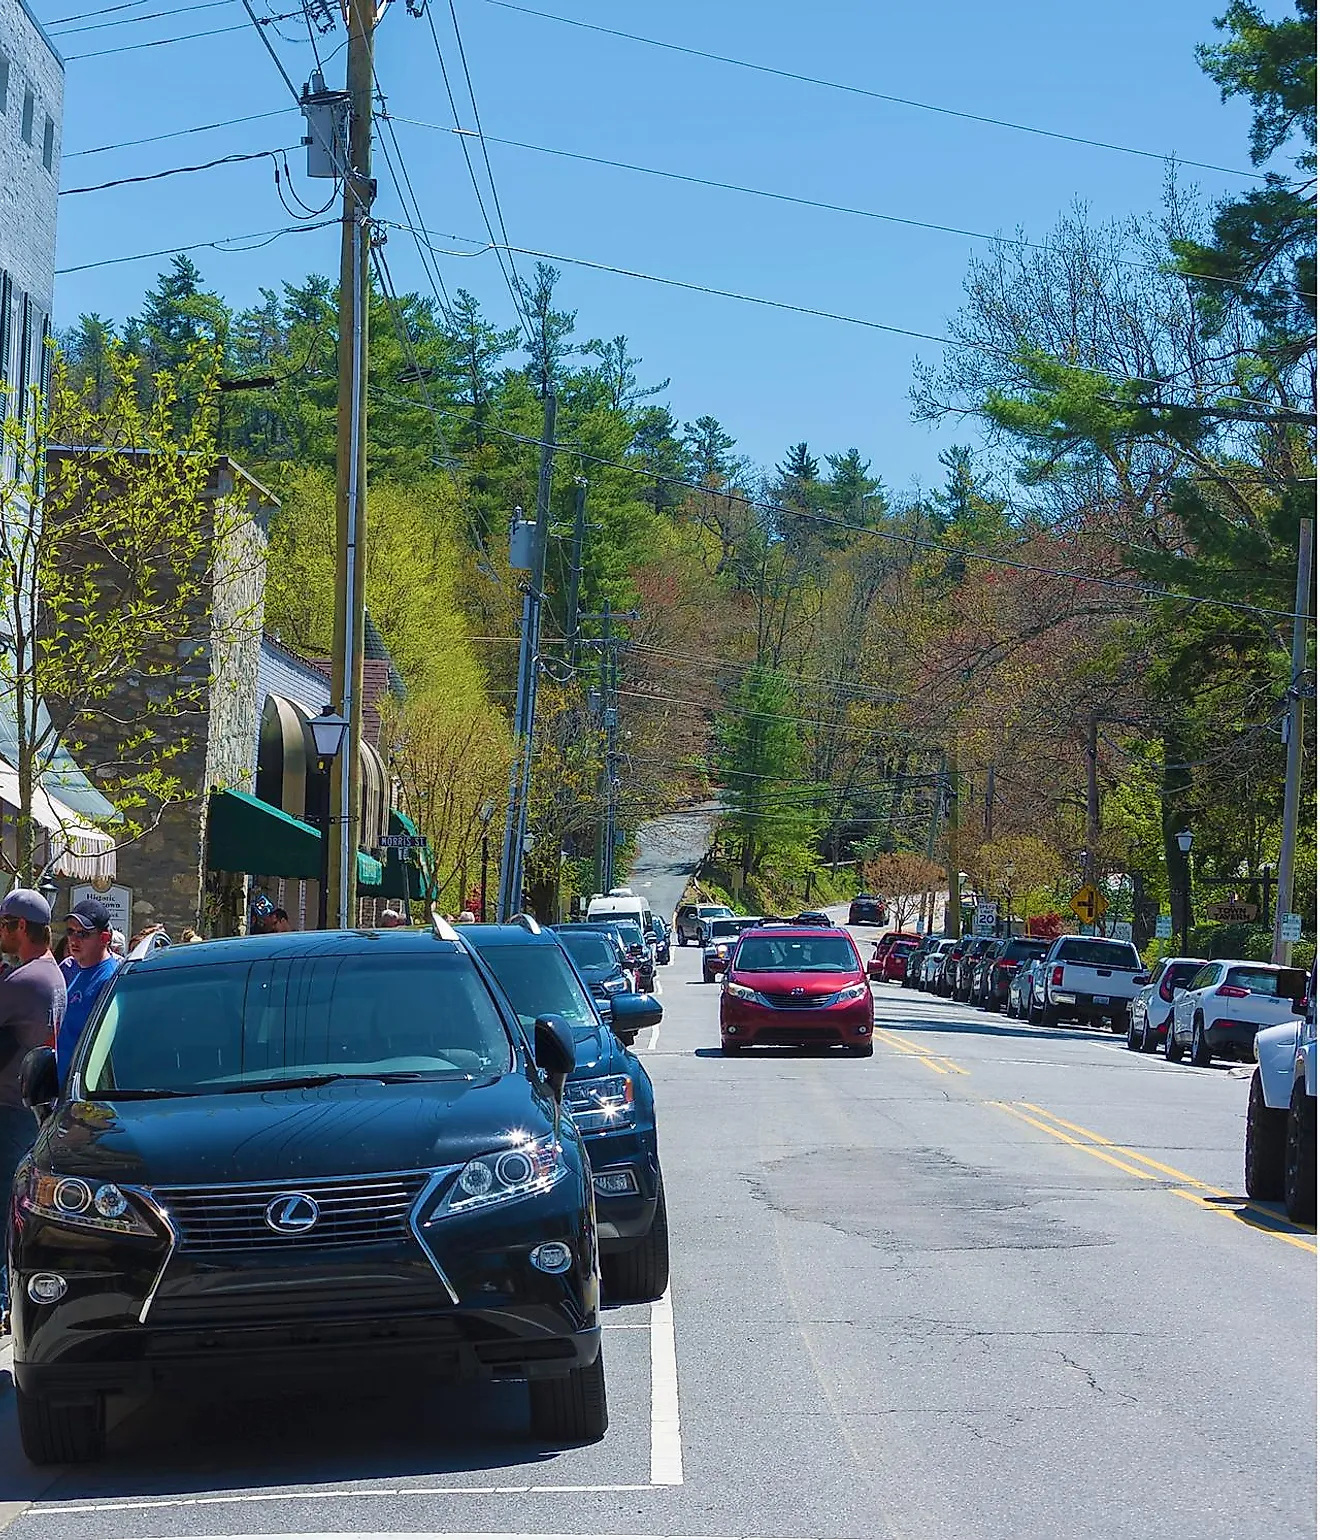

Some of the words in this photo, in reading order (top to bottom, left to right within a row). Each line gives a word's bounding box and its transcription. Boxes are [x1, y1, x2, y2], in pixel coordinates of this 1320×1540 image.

[381, 837, 411, 847] MORRIS
[414, 837, 425, 847] ST
[979, 914, 995, 924] 20
